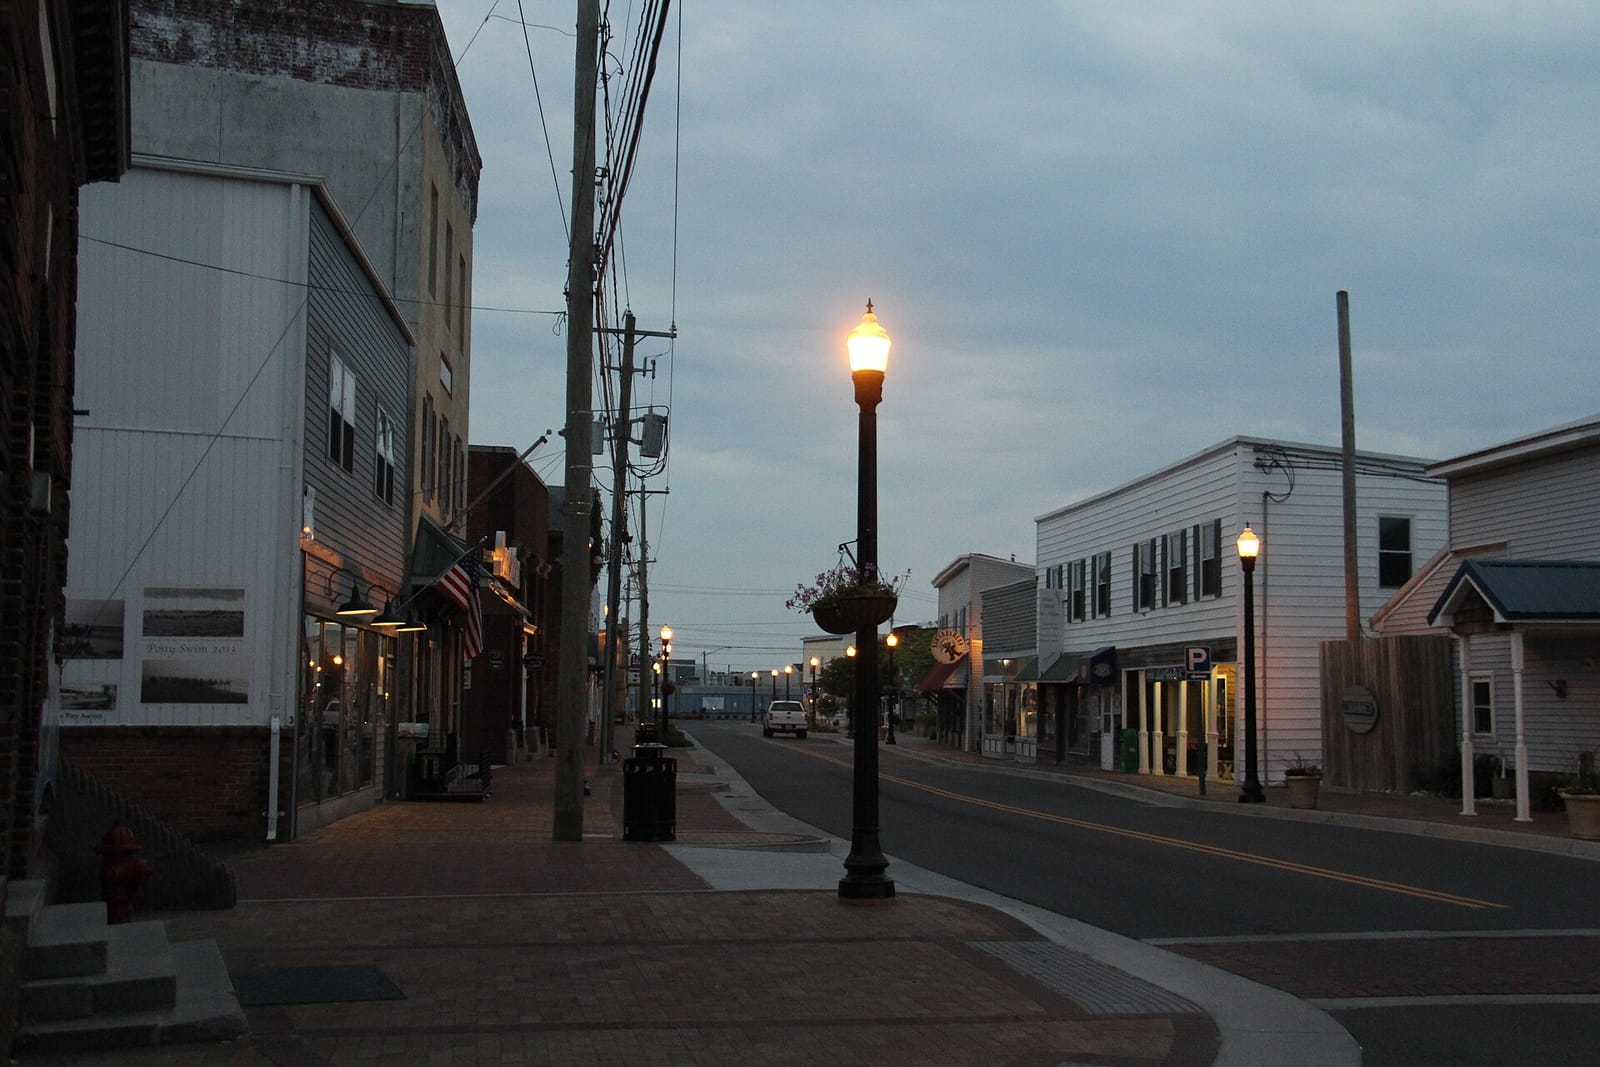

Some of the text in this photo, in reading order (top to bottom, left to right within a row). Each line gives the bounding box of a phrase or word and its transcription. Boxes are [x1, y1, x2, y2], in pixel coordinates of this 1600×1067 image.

[146, 643, 175, 657] Pony
[179, 643, 207, 654] Swim
[1189, 648, 1207, 670] P
